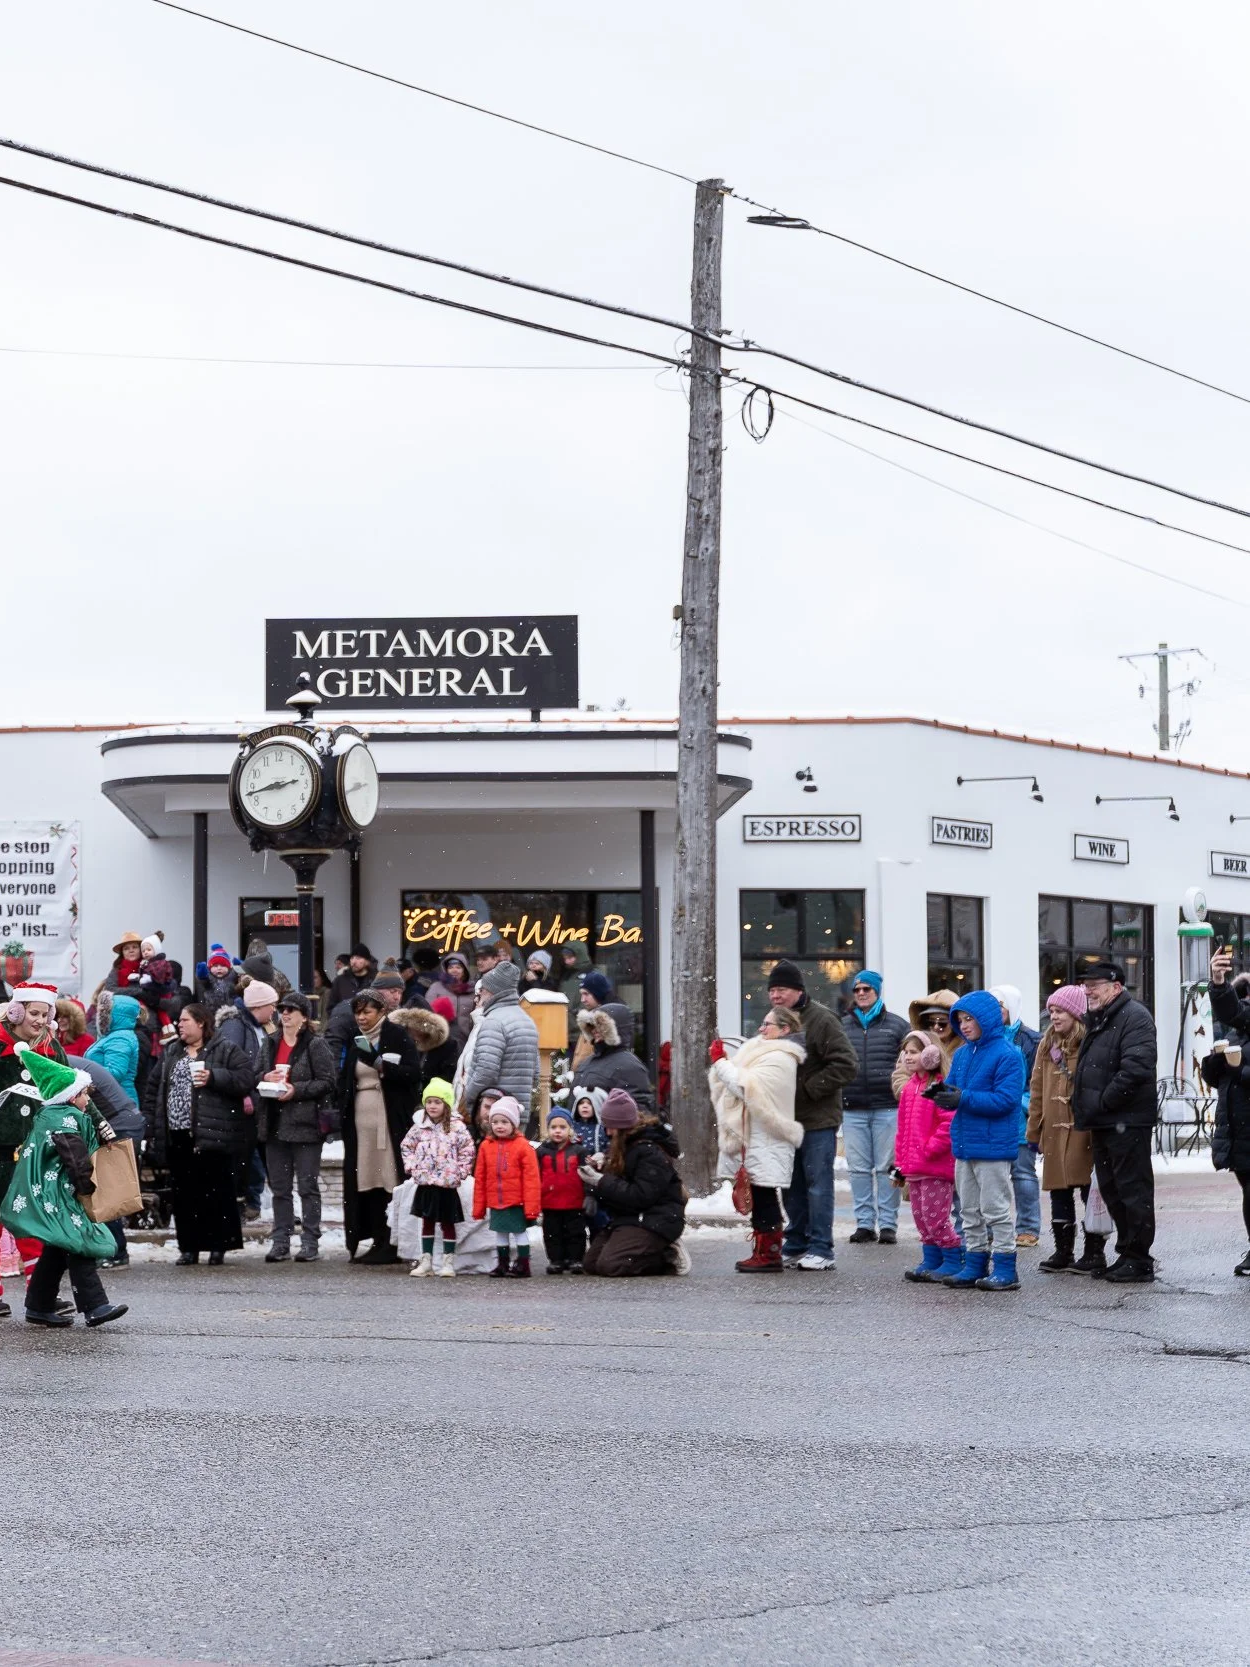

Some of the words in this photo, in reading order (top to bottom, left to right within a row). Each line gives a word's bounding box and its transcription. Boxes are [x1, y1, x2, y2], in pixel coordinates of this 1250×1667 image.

[292, 627, 553, 659] METAMORA
[316, 666, 528, 697] GENERAL
[251, 728, 272, 745] VILLAGE
[280, 726, 310, 742] METAMORA
[263, 756, 270, 767] 11
[274, 751, 283, 762] 12
[252, 769, 261, 779] 10
[253, 796, 260, 806] 8
[276, 810, 282, 820] 6
[290, 804, 297, 815] 5
[749, 820, 856, 837] ESPRESSO
[936, 823, 989, 844] PASTRIES
[14, 840, 50, 854] stop
[1088, 841, 1117, 858] WINE
[1223, 858, 1248, 873] BEER
[6, 903, 42, 917] your
[267, 913, 299, 927] OPEN
[22, 922, 59, 937] list...
[406, 908, 493, 952] Coffee
[517, 914, 589, 947] Wine
[596, 913, 643, 947] Ba
